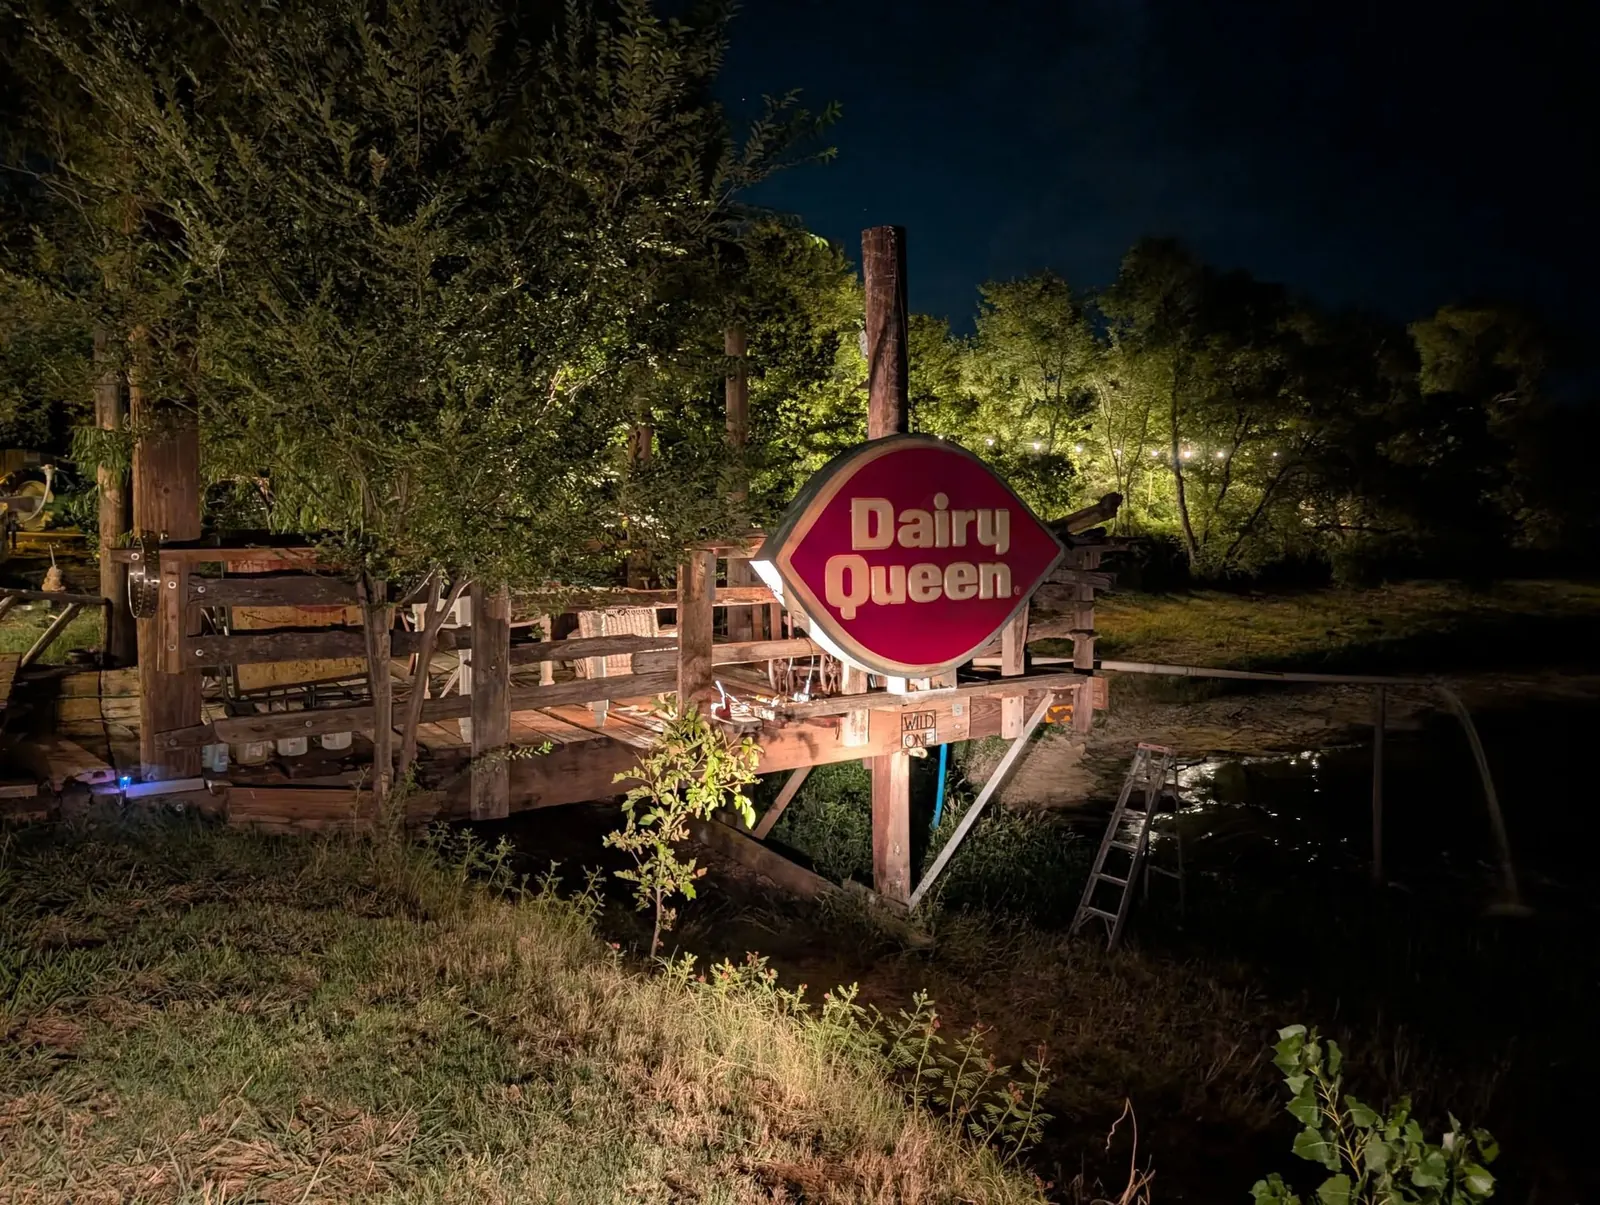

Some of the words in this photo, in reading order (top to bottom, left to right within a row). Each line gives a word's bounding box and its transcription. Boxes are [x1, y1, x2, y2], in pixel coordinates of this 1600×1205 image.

[851, 492, 1010, 555] Dairy
[825, 554, 1012, 620] Queen
[904, 714, 934, 730] WILD
[905, 732, 933, 748] ONE
